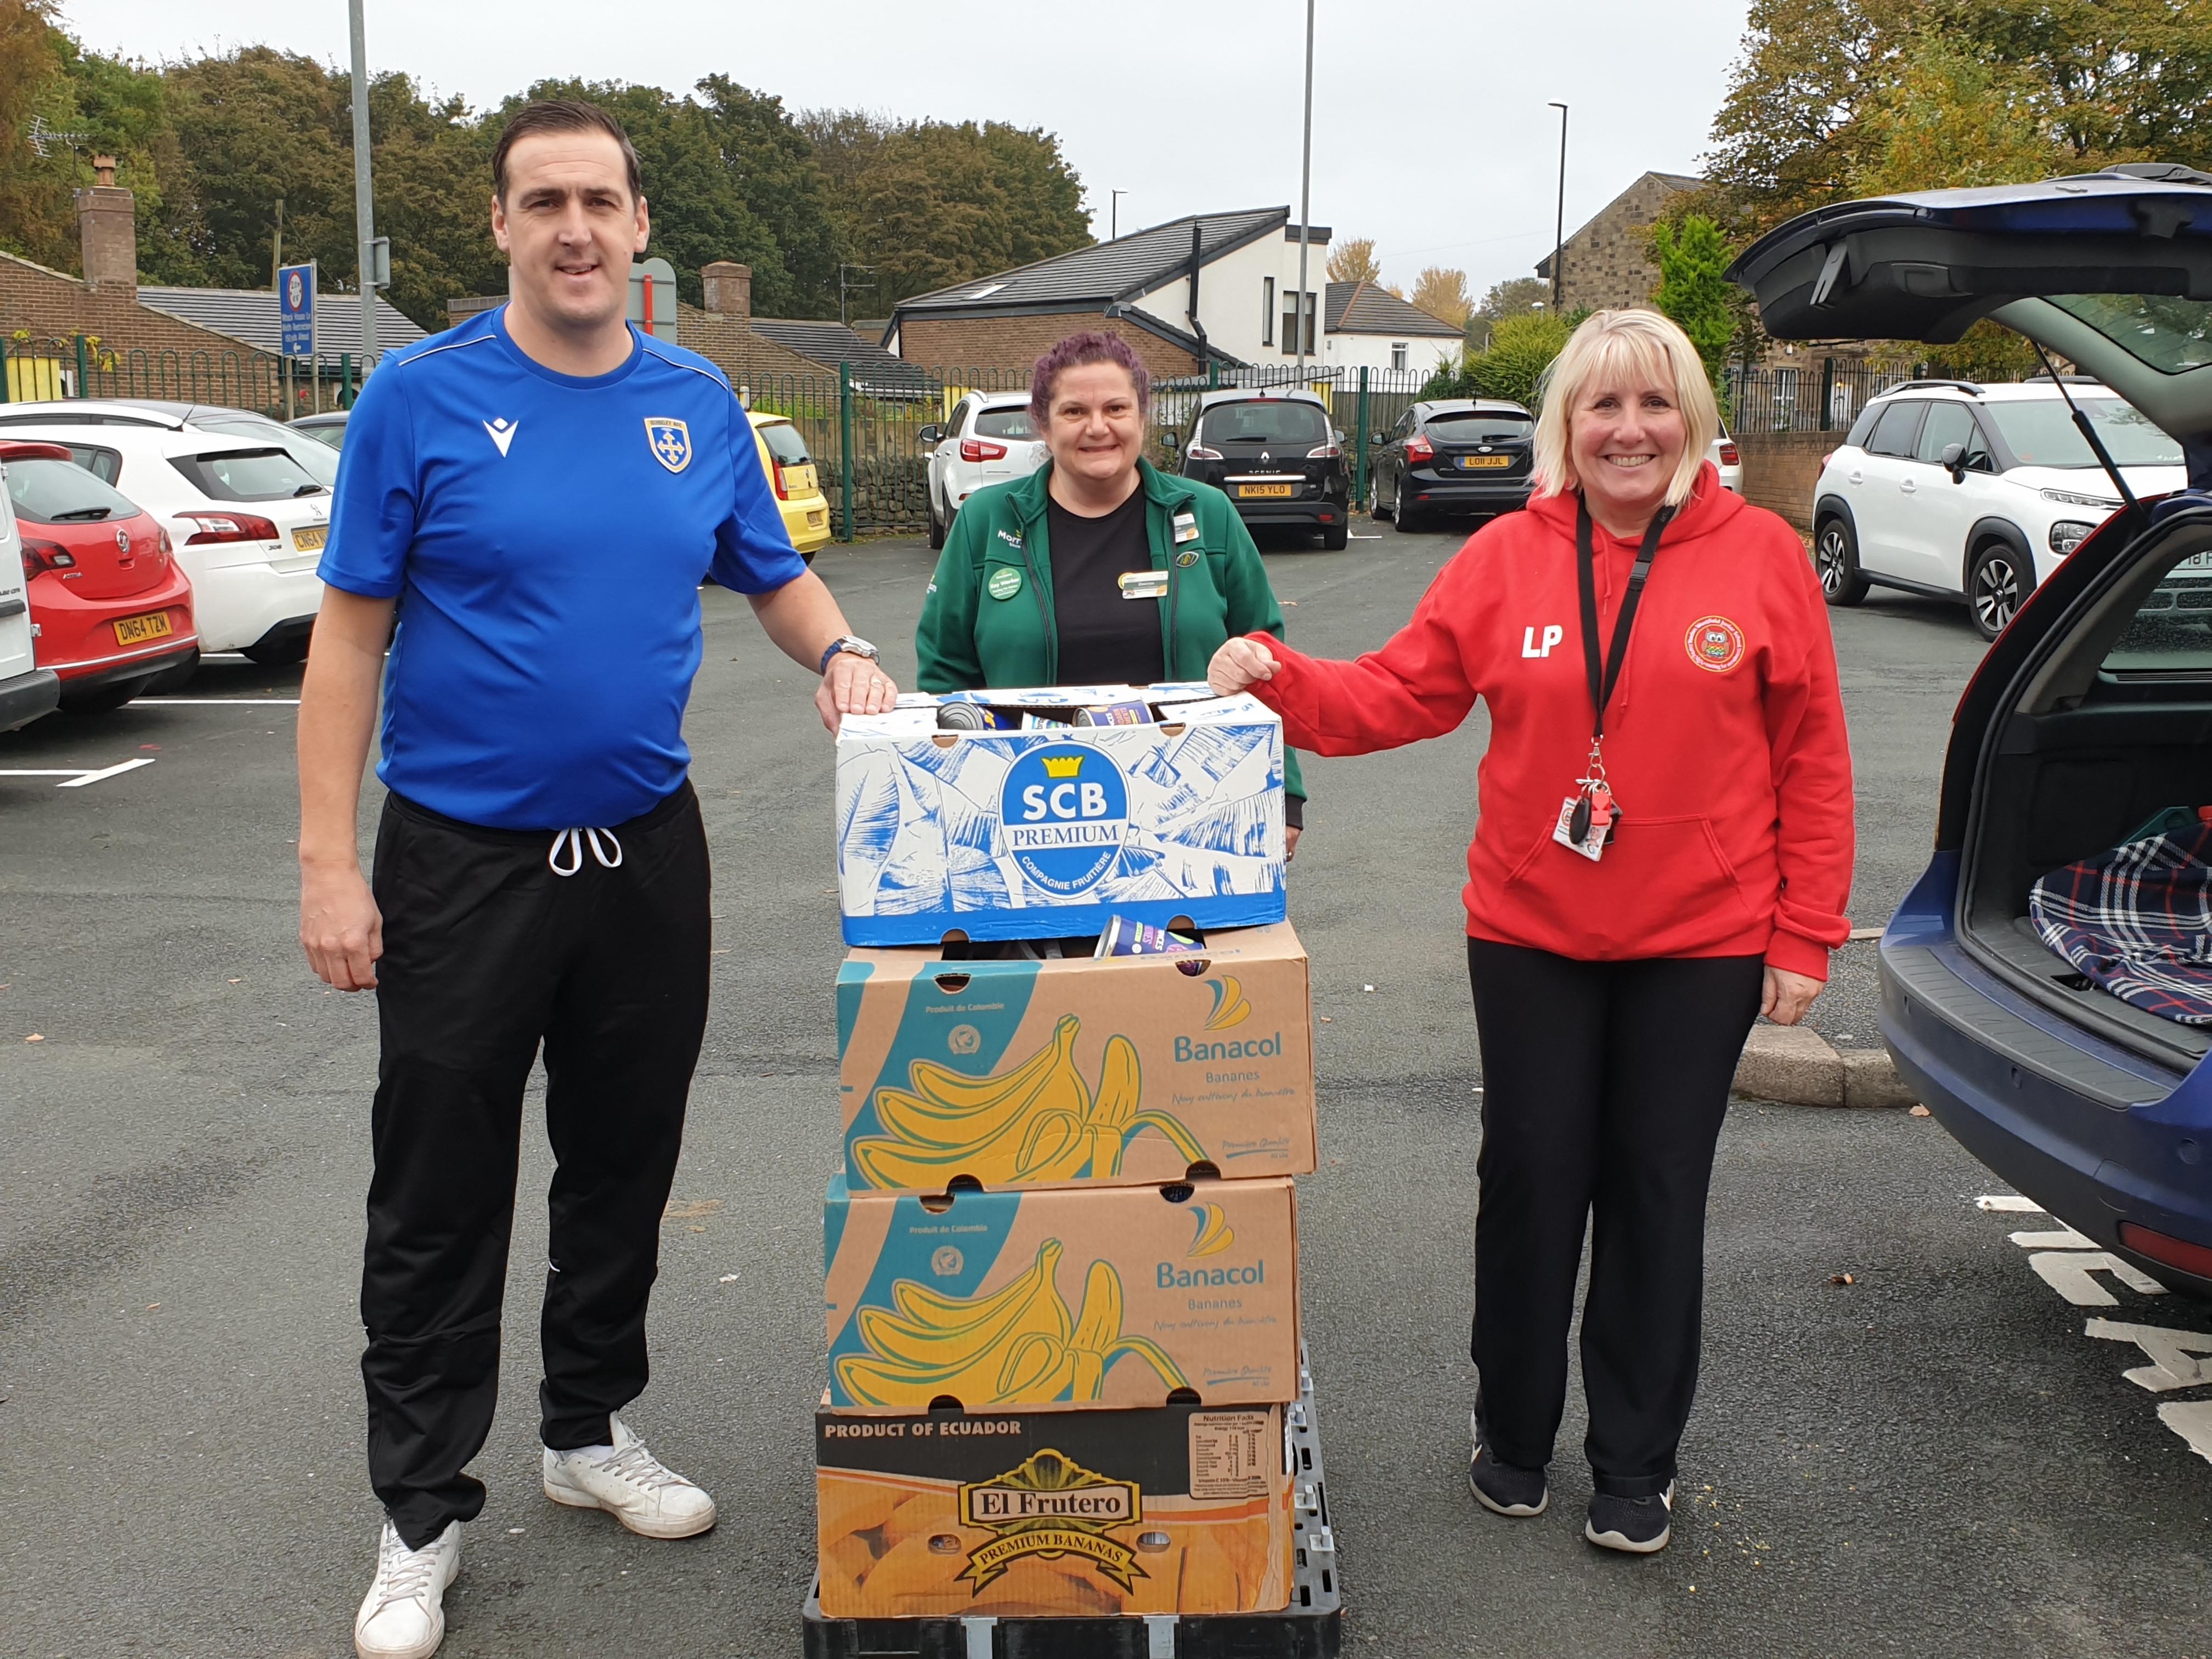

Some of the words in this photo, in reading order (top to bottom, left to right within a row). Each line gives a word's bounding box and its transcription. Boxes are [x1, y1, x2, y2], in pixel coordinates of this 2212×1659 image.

[1244, 486, 1265, 494] NK15
[1267, 486, 1285, 494] YLO
[295, 531, 319, 548] CN64
[119, 618, 147, 640] DN64
[1521, 624, 1563, 658] LP
[1022, 782, 1107, 821] SCB
[1012, 825, 1119, 847] PREMIUM
[1022, 856, 1070, 890] COMPAGNIE
[1073, 851, 1111, 889] FRUITIÈRE
[926, 1005, 955, 1013] Produit
[967, 1002, 1005, 1011] Colombie
[1173, 1031, 1281, 1063] Banacol
[1206, 1071, 1260, 1084] Bananes
[909, 1226, 938, 1234] Produit
[951, 1224, 988, 1232] Colombie
[1156, 1259, 1264, 1289] Banacol
[1188, 1298, 1242, 1311] Bananes
[825, 1423, 906, 1438] PRODUCT
[912, 1423, 934, 1436] OF
[939, 1421, 1022, 1436] ECUADOR
[980, 1492, 1011, 1515] El
[1018, 1492, 1121, 1514] Frutero
[979, 1534, 1051, 1565] PREMIUM
[1053, 1534, 1123, 1563] BANANAS
